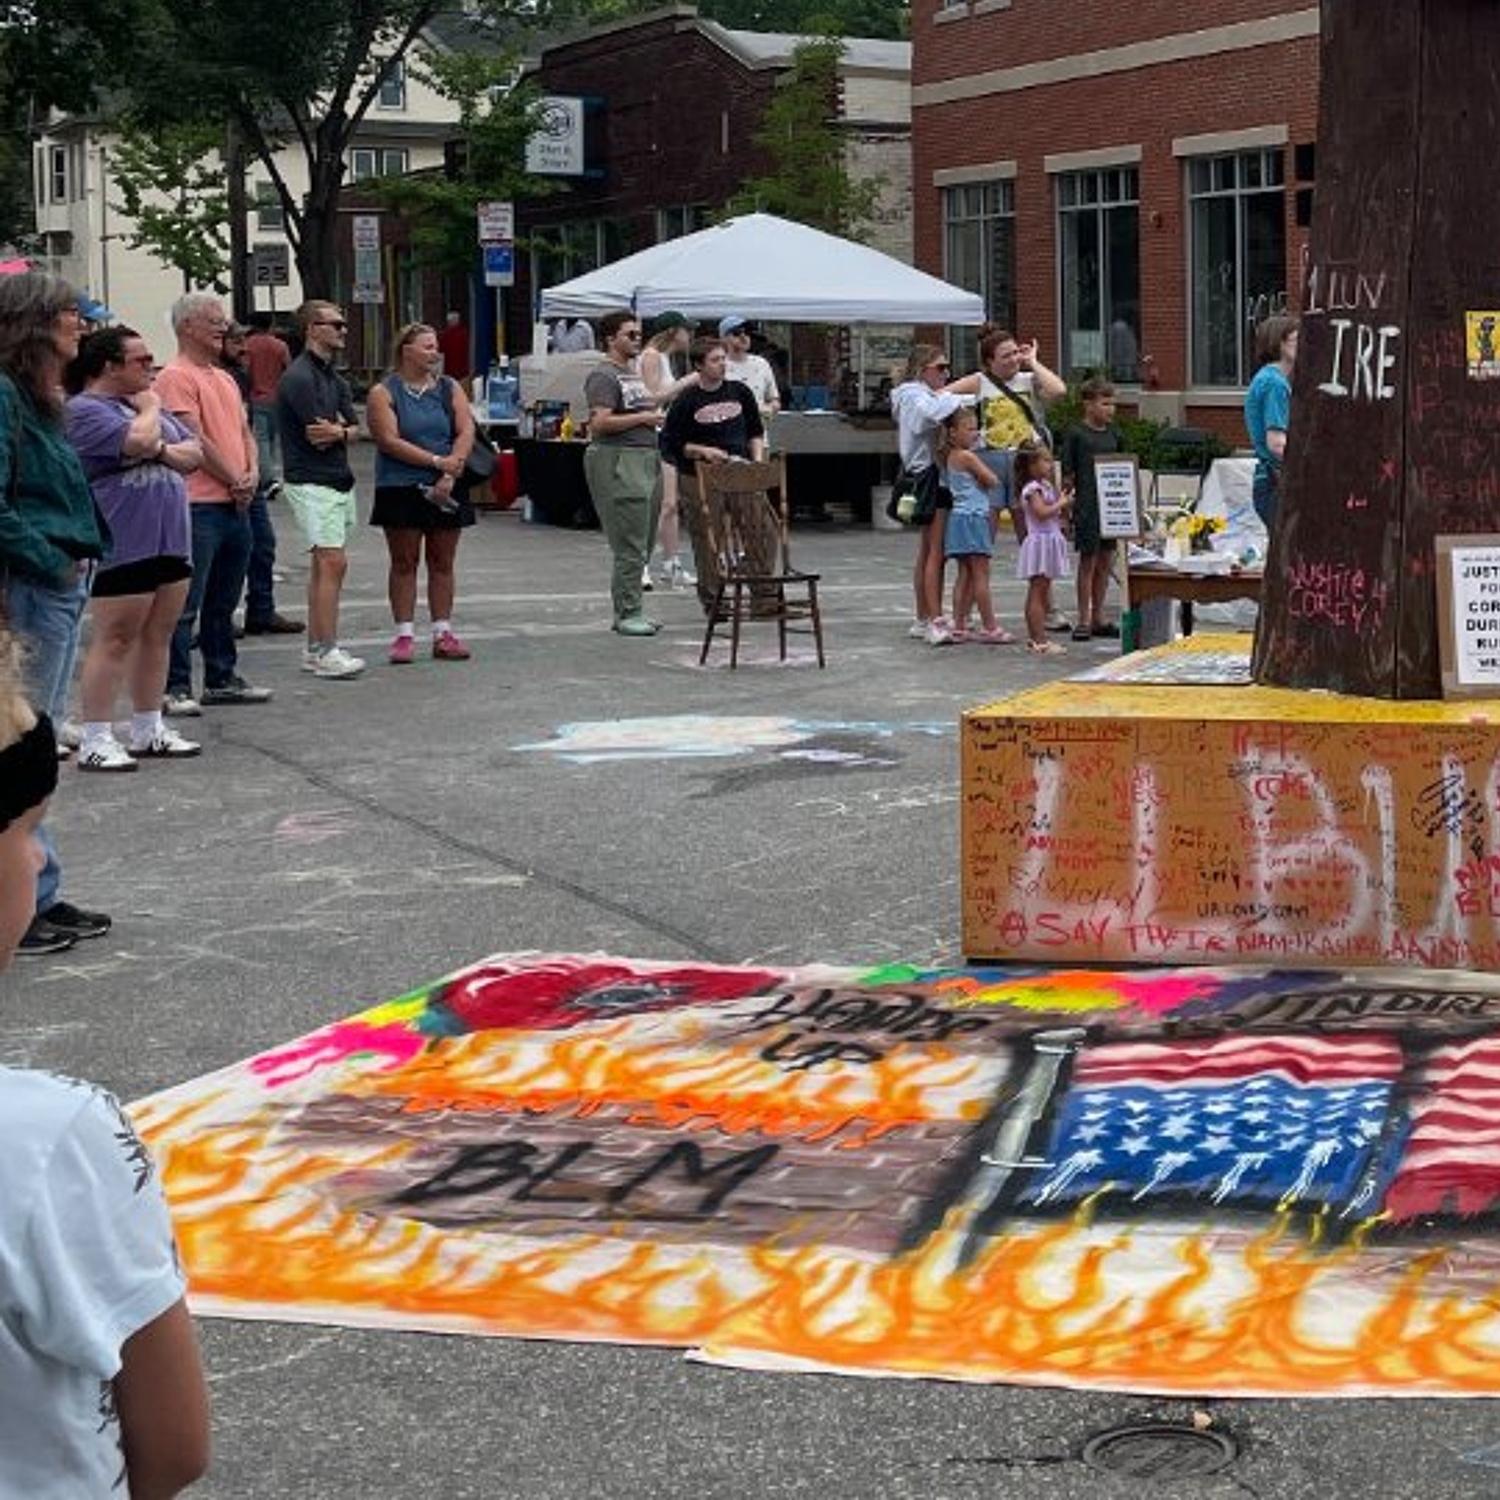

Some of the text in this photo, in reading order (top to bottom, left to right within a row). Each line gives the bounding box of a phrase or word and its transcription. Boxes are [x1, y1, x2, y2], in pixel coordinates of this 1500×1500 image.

[257, 265, 287, 281] 25
[1317, 318, 1401, 402] IRE
[1035, 912, 1112, 947] SAY
[396, 1140, 781, 1214] BLM
